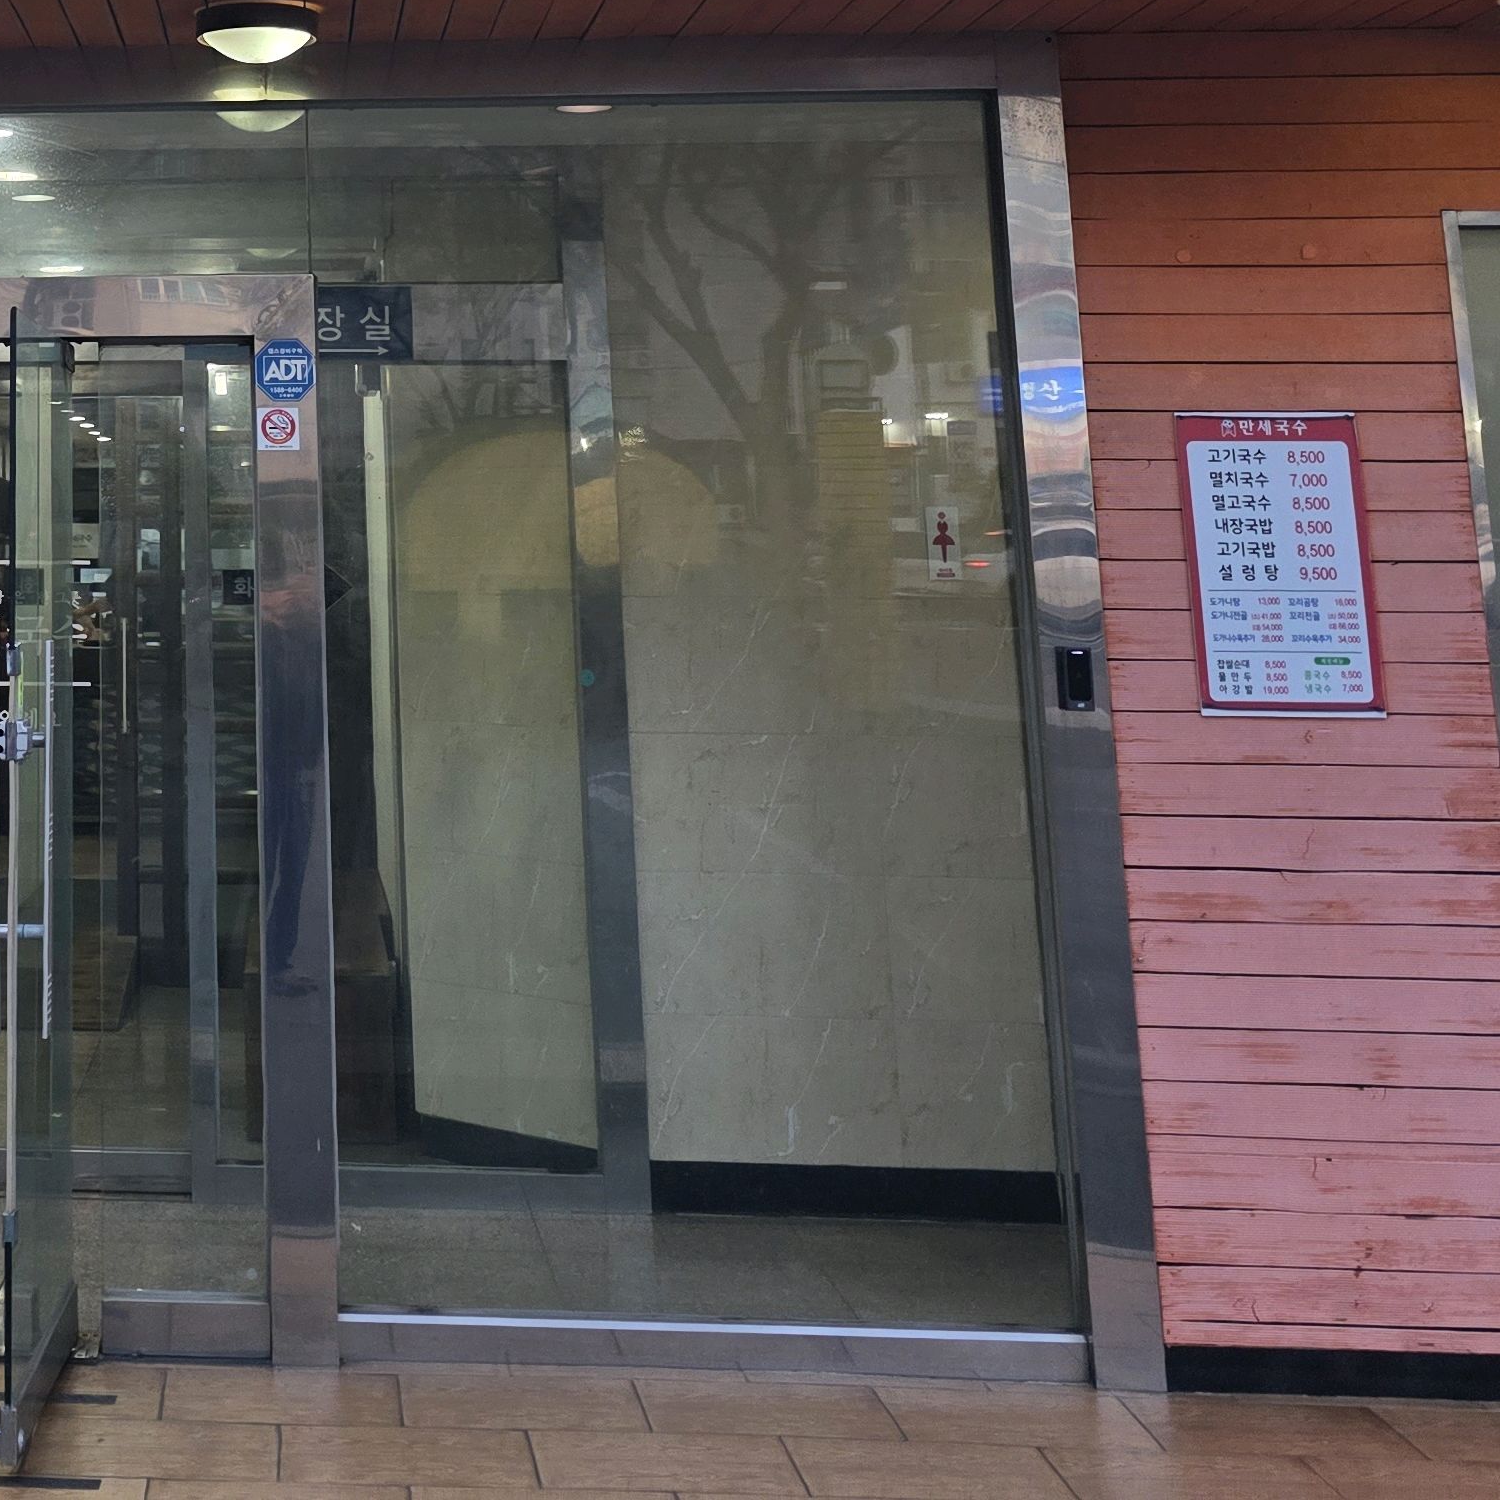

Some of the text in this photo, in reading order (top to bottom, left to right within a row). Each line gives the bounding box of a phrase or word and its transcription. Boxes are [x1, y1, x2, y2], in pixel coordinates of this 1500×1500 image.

[264, 359, 306, 381] ADT
[1238, 419, 1308, 436] 만세국수
[1207, 448, 1325, 466] 고기국수 8,500
[1209, 471, 1328, 489] 멸치국수 7,000
[1212, 494, 1331, 512] 멸고국수 8,500
[1214, 518, 1333, 536] 내장국밥 8,500
[1217, 541, 1335, 560] 고기국밥 8,500
[1299, 566, 1338, 582] 9,500
[1209, 597, 1241, 607] 도가니탕
[1211, 610, 1248, 621] 도가니전골
[1289, 611, 1320, 621] 꼬리전골
[1264, 660, 1287, 670] 8,500
[1266, 672, 1288, 683] 8,500
[1263, 685, 1290, 695] 19,000
[1342, 684, 1364, 694] 7,000
